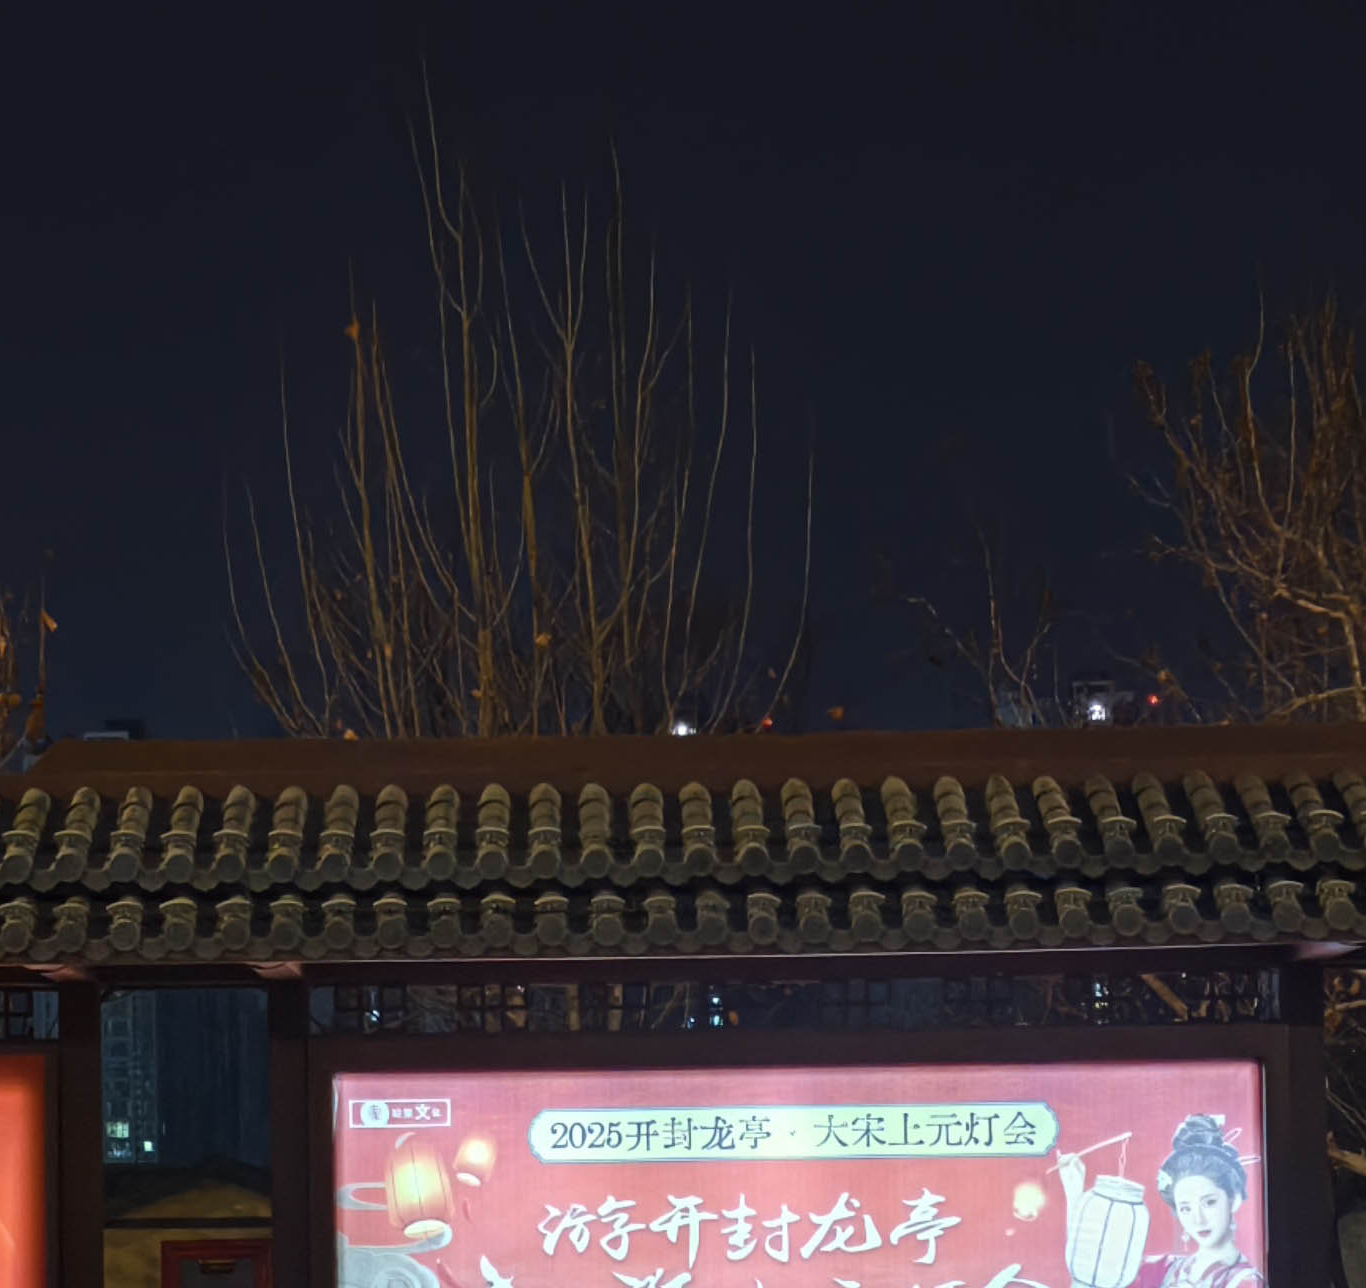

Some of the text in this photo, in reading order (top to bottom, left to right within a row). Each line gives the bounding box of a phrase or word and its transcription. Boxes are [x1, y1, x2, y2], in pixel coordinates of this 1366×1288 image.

[538, 1187, 962, 1269] 游开封龙亭
